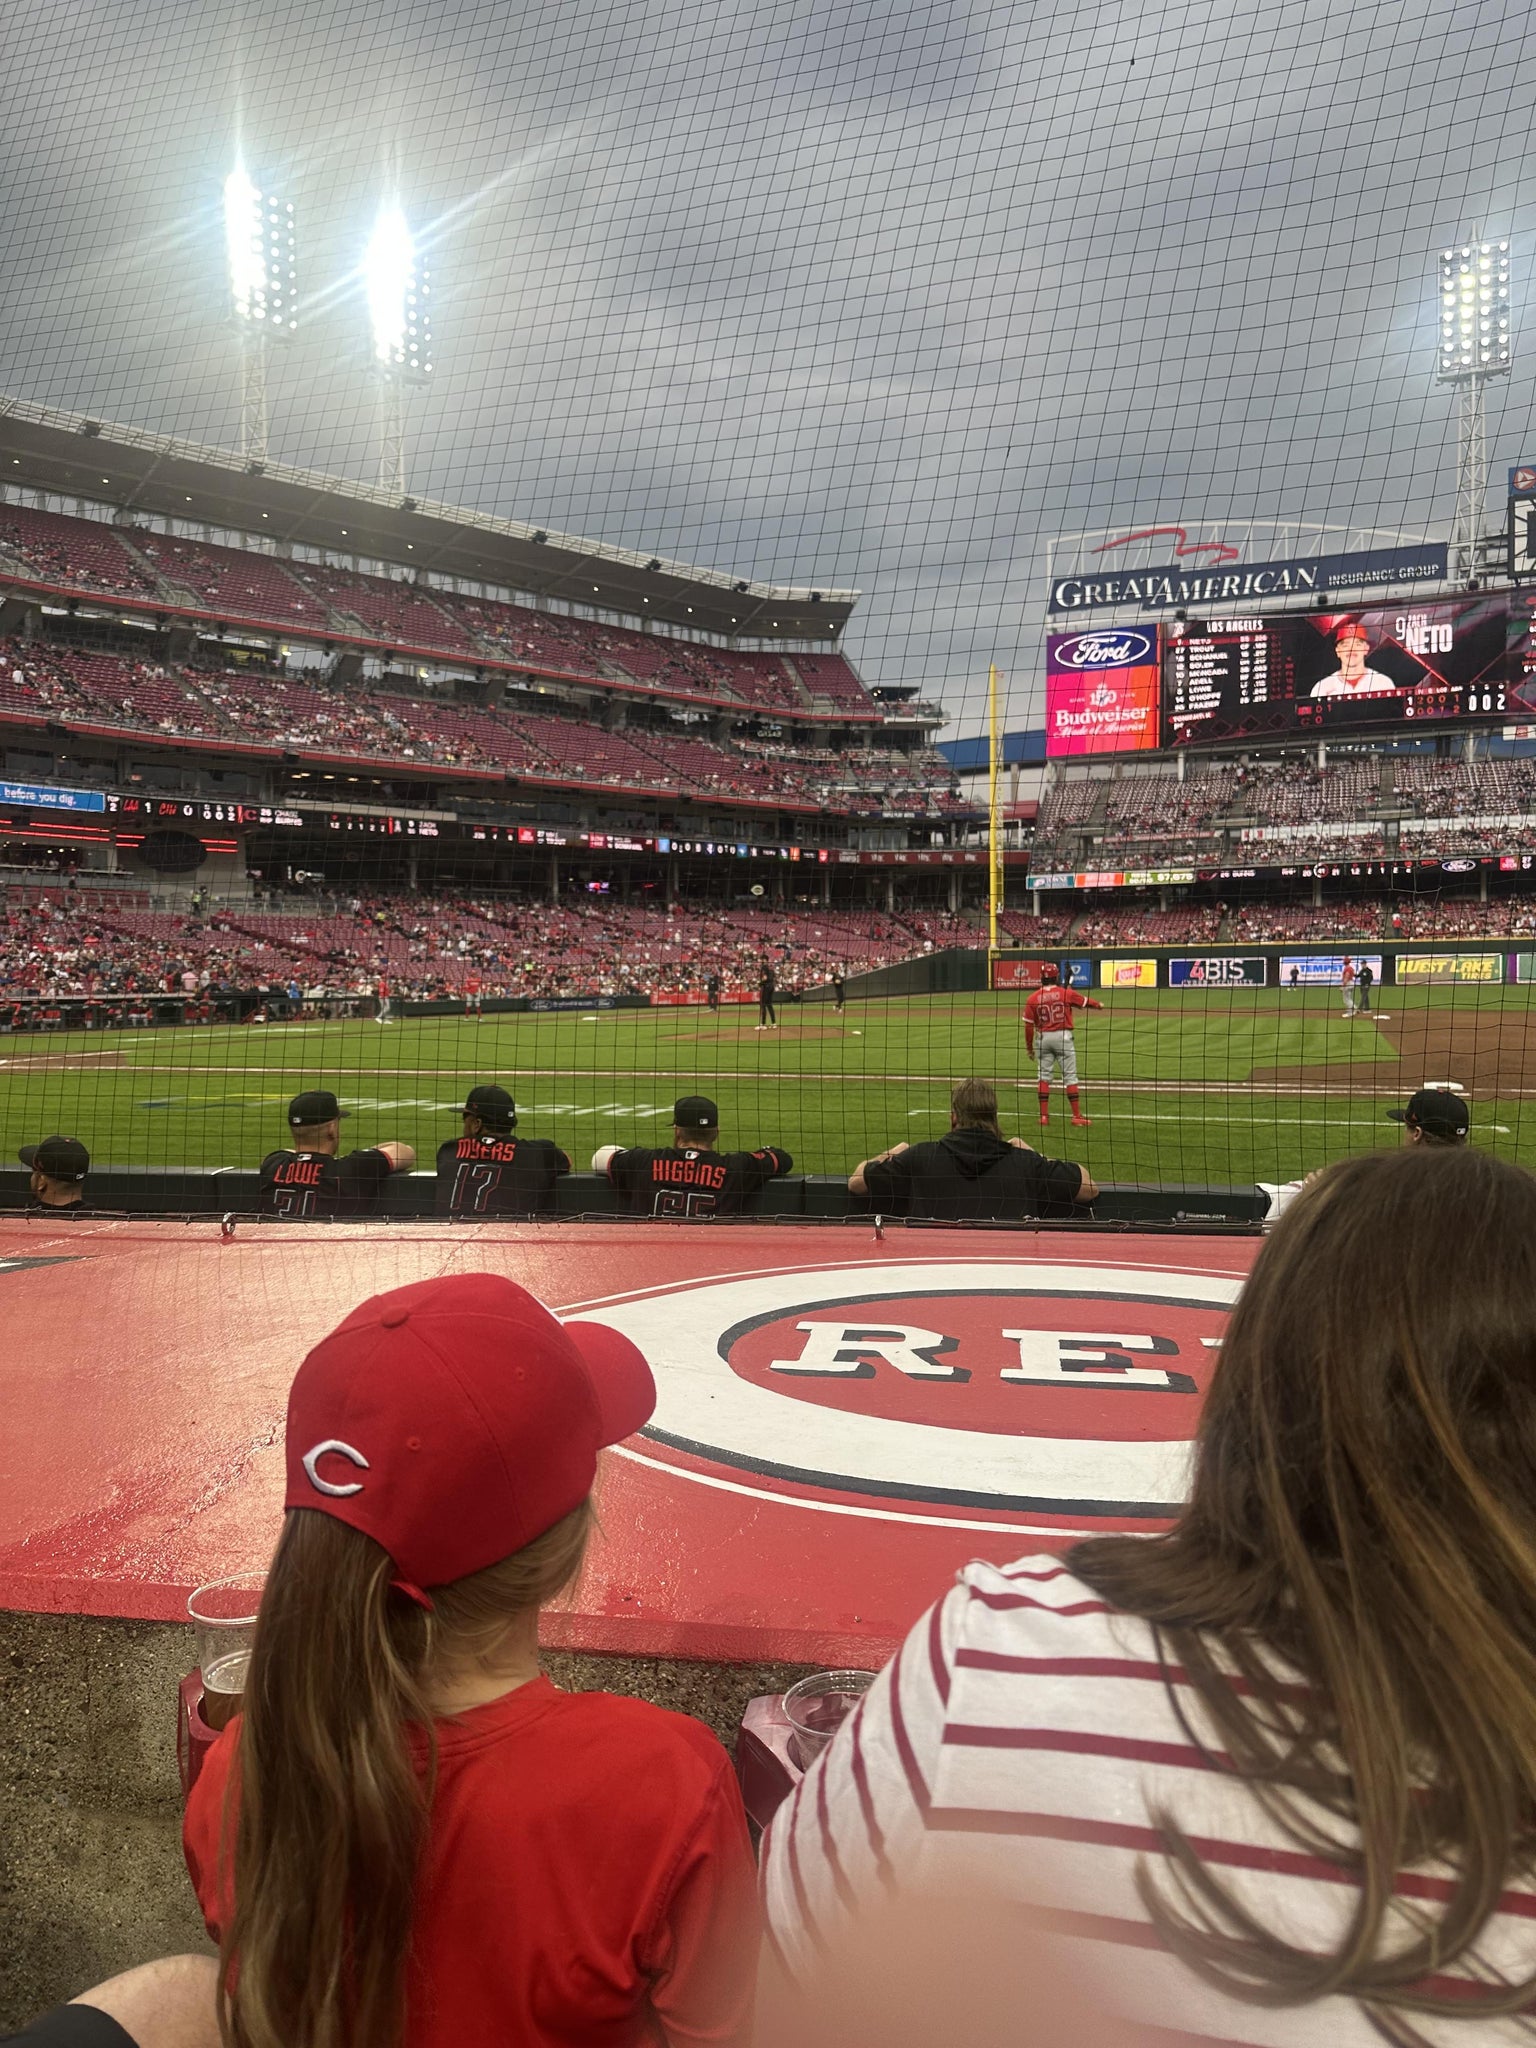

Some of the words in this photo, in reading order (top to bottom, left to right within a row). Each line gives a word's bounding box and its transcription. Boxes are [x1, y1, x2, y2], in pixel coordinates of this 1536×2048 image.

[1055, 576, 1160, 608] GREAT
[1147, 566, 1318, 605] AMERICAN
[1328, 568, 1395, 586] INSURANCE
[1399, 564, 1439, 579] GROUP
[1206, 621, 1224, 633] LOS
[1226, 619, 1263, 632] ANGELES
[1072, 636, 1131, 664] Ford
[1405, 624, 1453, 655] NETO
[1407, 696, 1413, 705] 1
[1468, 695, 1477, 711] 0
[1482, 694, 1491, 711] 0
[1497, 694, 1505, 710] 2
[1055, 705, 1150, 726] Budweiser
[1406, 707, 1414, 716] 0
[4, 787, 36, 800] before
[39, 794, 57, 803] you
[59, 794, 77, 806] dig.
[109, 803, 118, 812] 2
[145, 802, 151, 813] 1
[183, 805, 193, 816] 0
[203, 811, 212, 819] 0
[215, 811, 224, 820] 0
[228, 813, 235, 821] 2
[1300, 964, 1344, 973] TEMPST
[1398, 959, 1447, 974] WEST
[1449, 958, 1495, 973] LAKE
[456, 1138, 515, 1162] MYERS
[273, 1162, 323, 1185] LOWE
[652, 1159, 727, 1189] HIGGINS
[450, 1163, 502, 1211] 17
[770, 1320, 1224, 1394] RE
[302, 1439, 370, 1497] C
